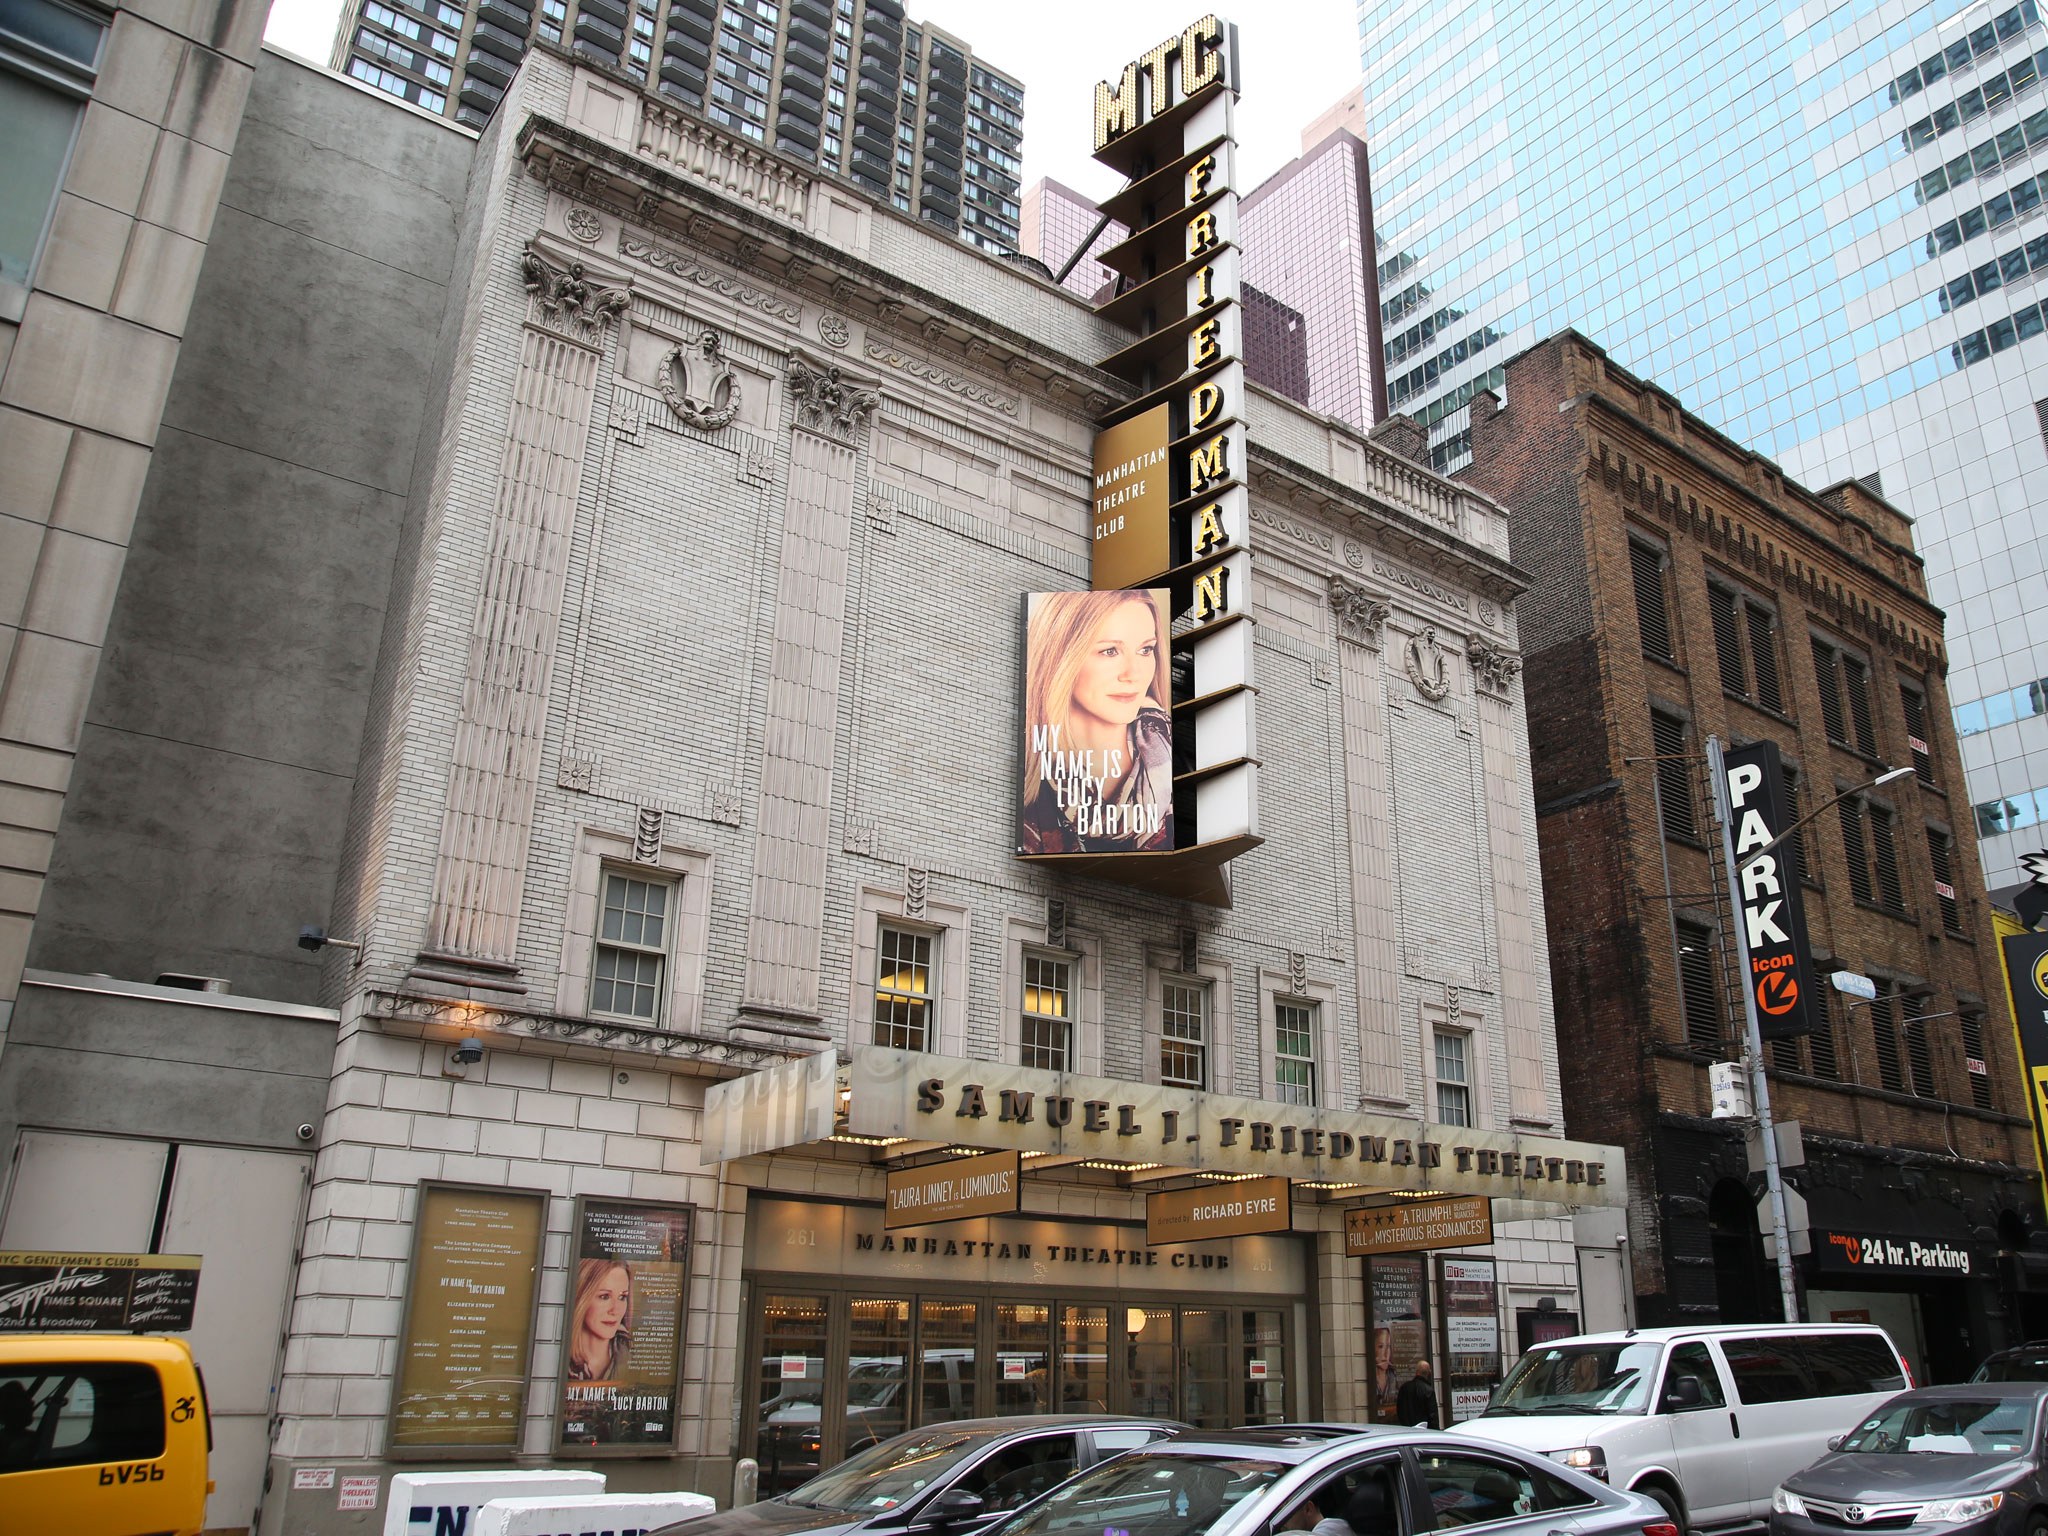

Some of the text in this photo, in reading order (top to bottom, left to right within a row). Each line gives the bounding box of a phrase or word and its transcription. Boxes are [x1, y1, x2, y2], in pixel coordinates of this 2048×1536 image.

[1094, 13, 1225, 151] MTC
[1188, 153, 1230, 622] FRIEDMAN
[1096, 446, 1165, 489] MANHATTAN
[1096, 480, 1146, 514] THEATRE
[1096, 515, 1125, 540] CLUB
[1033, 724, 1061, 754] MY
[1040, 750, 1122, 780] NAME IS
[1057, 777, 1105, 808] LUCY
[1077, 803, 1159, 835] BARTON
[1727, 762, 1790, 949] PARK
[1752, 953, 1794, 973] icon
[917, 1078, 1607, 1187] SAMUEL J. FRIEDMAN THEATRE
[923, 1180, 953, 1205] LINNEY
[953, 1191, 959, 1201] IS
[1158, 1197, 1276, 1225] directed by RICHARD EYRE
[1411, 1205, 1452, 1224] TRIUMPH!
[1453, 1201, 1481, 1212] BEAUTIFULLY
[1454, 1210, 1475, 1219] NUANCED
[786, 1229, 816, 1246] 261
[1350, 1232, 1368, 1247] FULL
[1375, 1226, 1424, 1244] MYSTERIOUS
[1828, 1232, 1847, 1245] icon
[24, 1255, 101, 1266] GENTLEMEN'S
[105, 1257, 139, 1267] CLUBS
[856, 1233, 1230, 1270] MANHATTAN THEATRE CLUB
[1861, 1238, 1970, 1274] 24 hr. Parking
[440, 1277, 473, 1289] MY NAME IS
[1446, 1266, 1464, 1278] MTC
[469, 1284, 506, 1295] LUCY BARTON
[43, 1296, 124, 1307] TIMES SQUARE
[28, 1318, 37, 1327] &
[40, 1317, 98, 1329] Broadway
[567, 1387, 617, 1401] MY NAME IS
[613, 1396, 668, 1411] LUCY BARTON
[1456, 1395, 1470, 1405] JOIN
[342, 1488, 376, 1497] THROUGHOUT
[343, 1478, 378, 1486] SPRINKLERS
